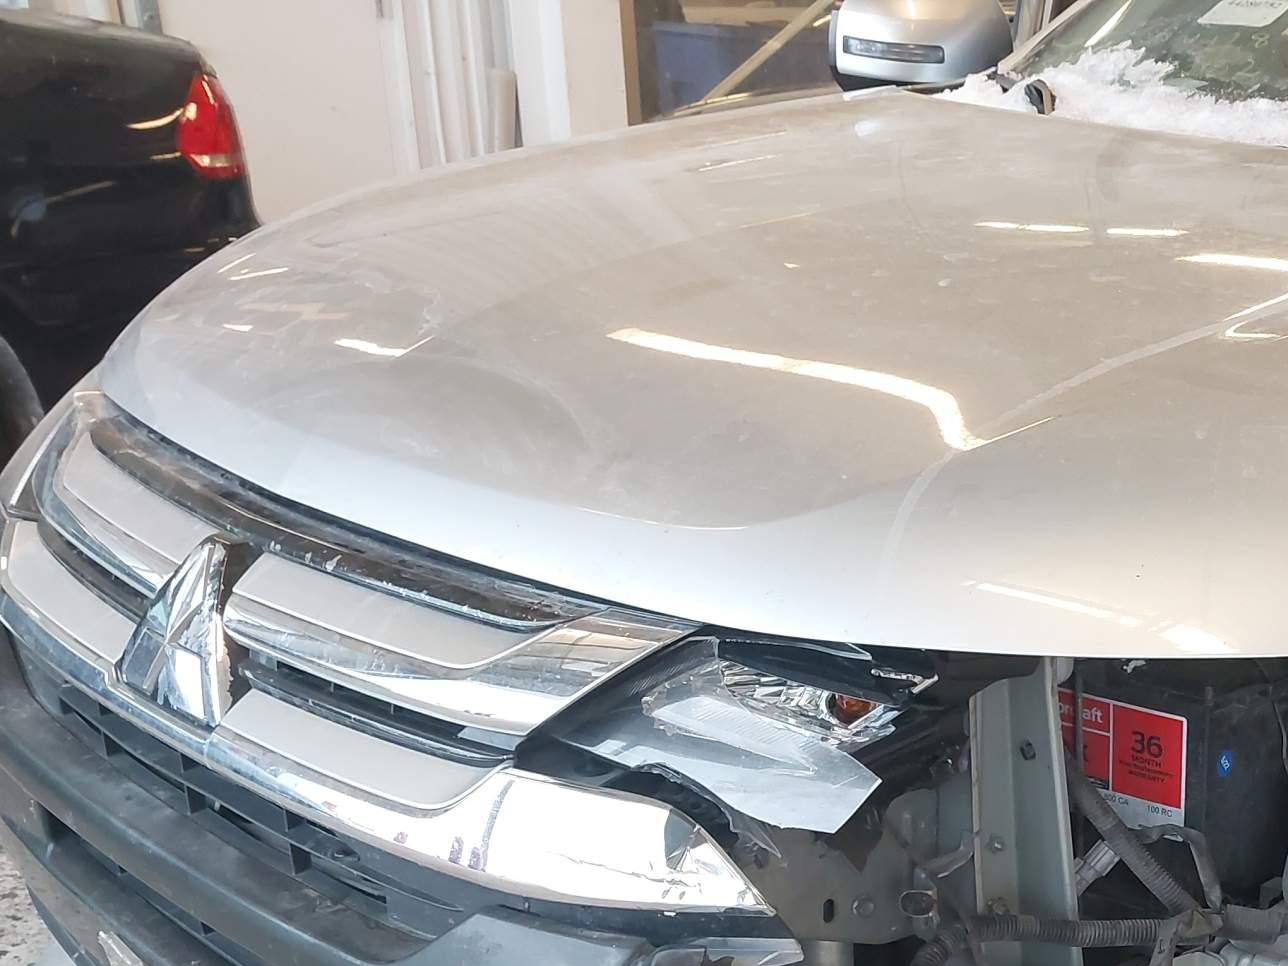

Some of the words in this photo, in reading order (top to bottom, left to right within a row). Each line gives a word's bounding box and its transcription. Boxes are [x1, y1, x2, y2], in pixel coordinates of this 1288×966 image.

[1131, 731, 1163, 758] 36
[1131, 754, 1162, 768] MONTH
[1147, 805, 1160, 814] 100
[1161, 807, 1173, 818] RC
